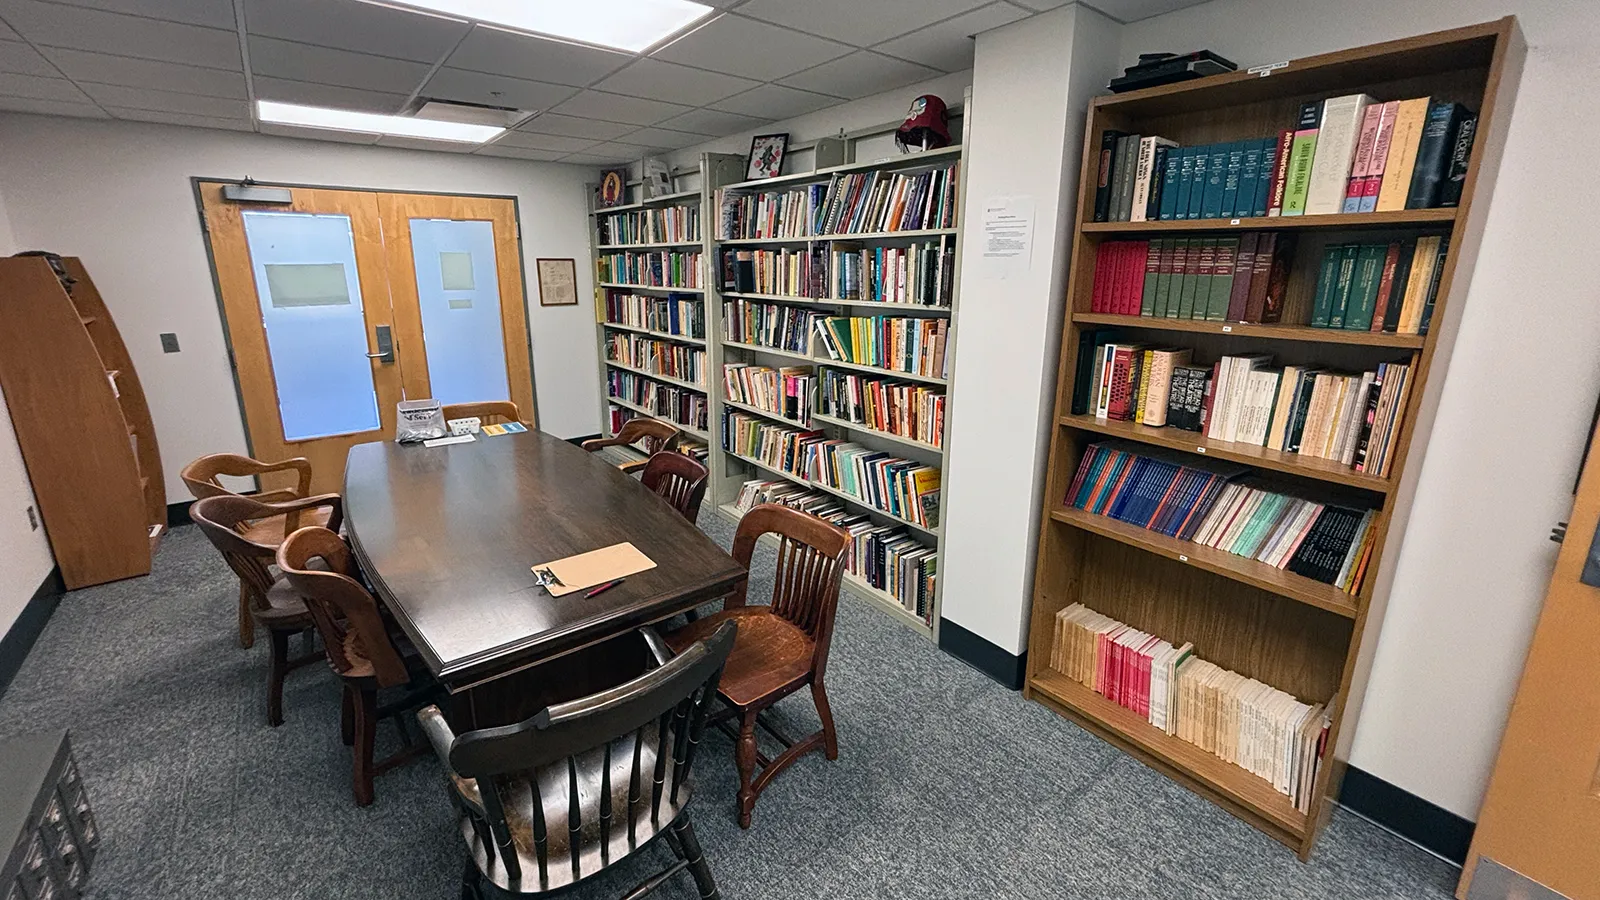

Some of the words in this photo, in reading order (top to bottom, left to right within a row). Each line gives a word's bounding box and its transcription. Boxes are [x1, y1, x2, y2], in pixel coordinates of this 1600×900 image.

[1461, 120, 1472, 138] ORAL
[1278, 132, 1293, 179] Afro-American
[1456, 138, 1467, 161] POETRY
[1273, 179, 1284, 206] Folklore
[1169, 376, 1178, 401] THEATRE
[1185, 378, 1194, 404] THEATRE
